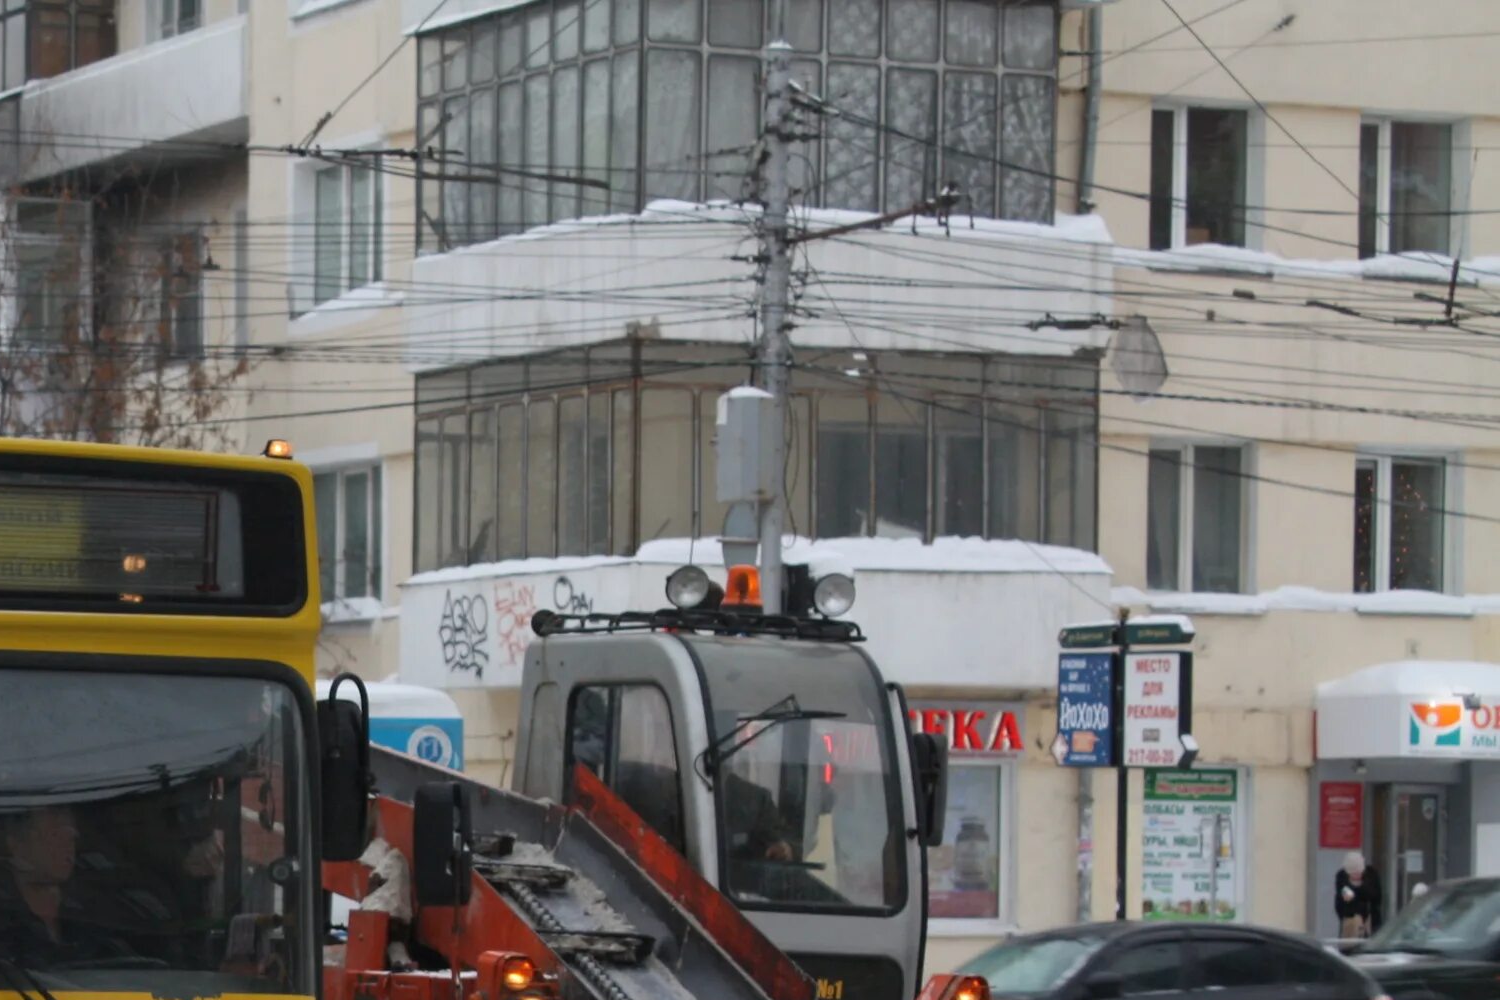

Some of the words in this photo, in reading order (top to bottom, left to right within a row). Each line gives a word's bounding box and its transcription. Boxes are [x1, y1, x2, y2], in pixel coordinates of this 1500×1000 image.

[1135, 658, 1171, 673] МЕСТО
[1142, 681, 1164, 697] ДЛЯ
[1126, 704, 1178, 720] РЕКЛАМЫ
